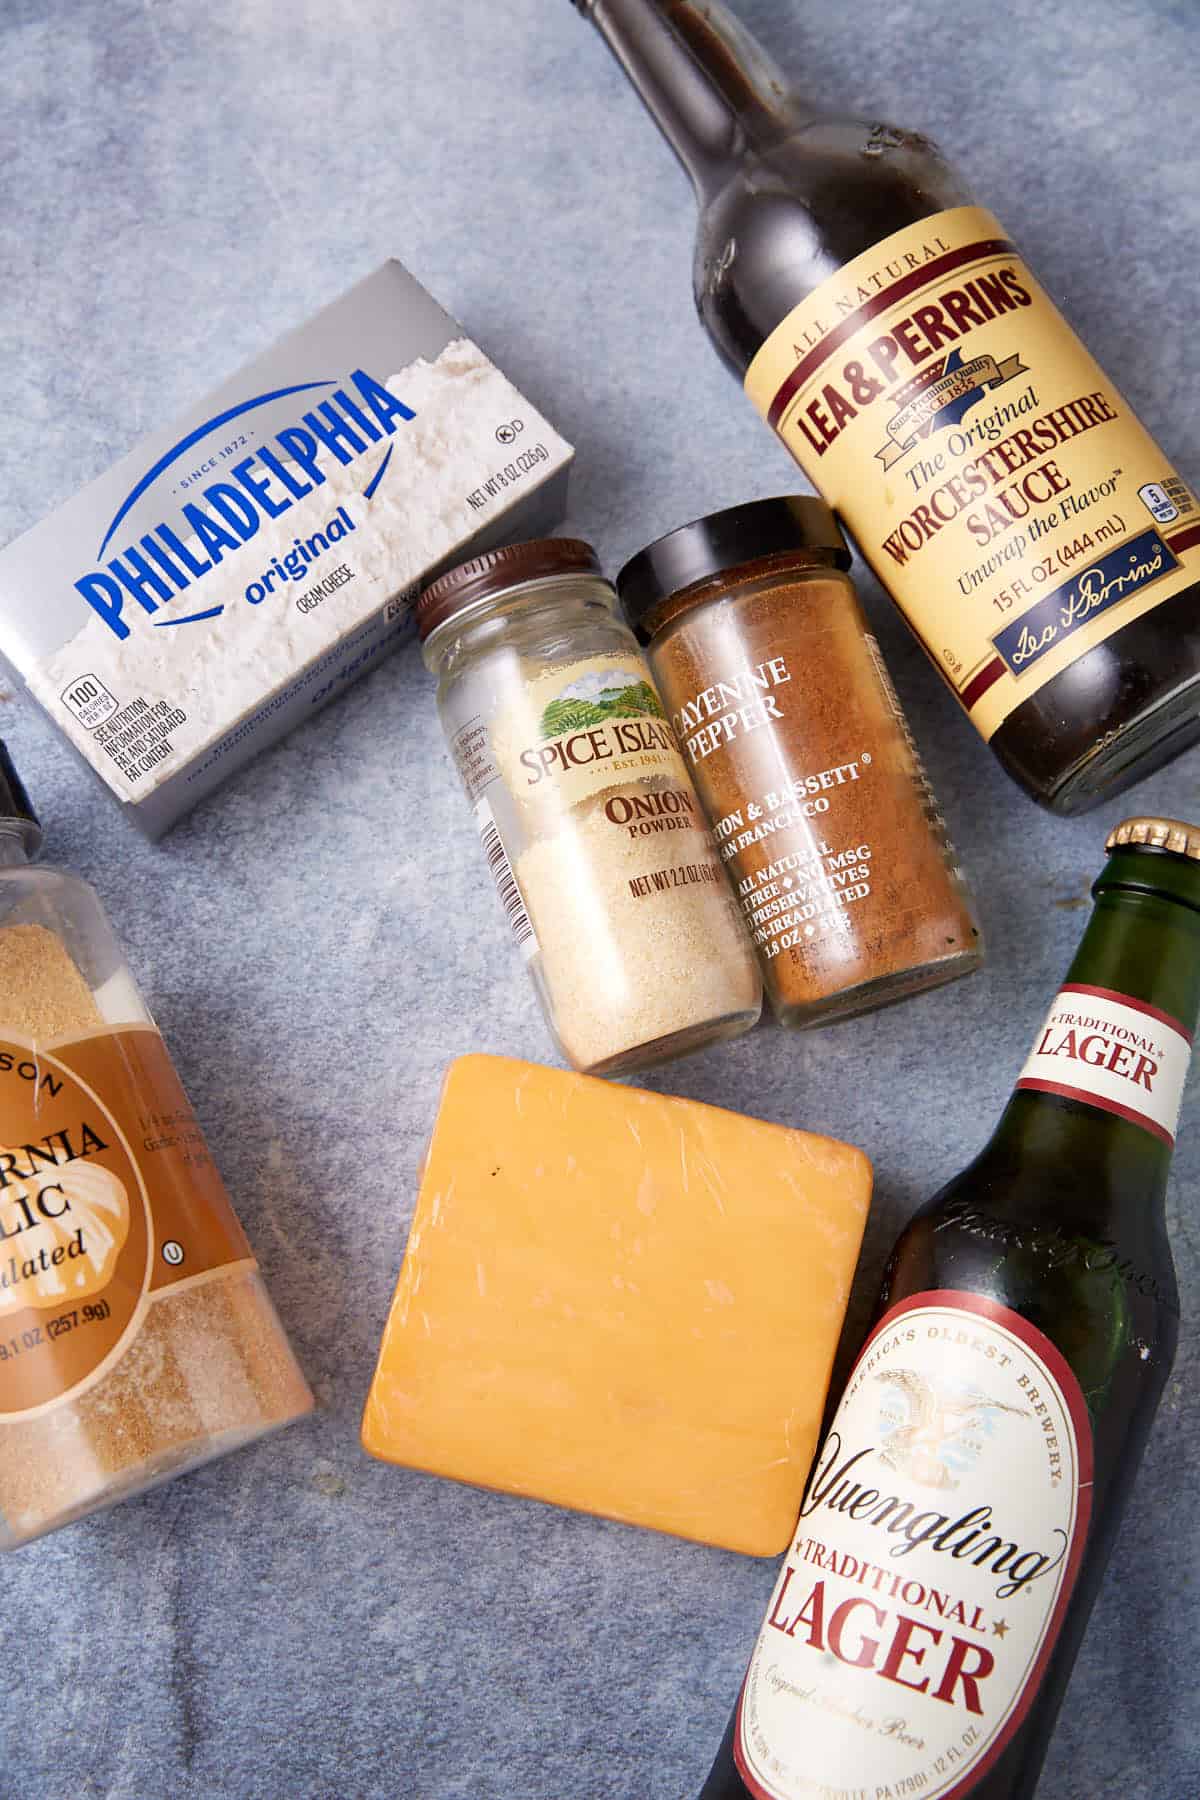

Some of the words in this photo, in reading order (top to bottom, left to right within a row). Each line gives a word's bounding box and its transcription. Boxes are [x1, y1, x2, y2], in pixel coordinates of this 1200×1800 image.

[791, 318, 829, 360] ALL
[835, 237, 952, 314] NATURAL
[954, 357, 991, 381] Quality
[911, 396, 946, 427] SINCE
[947, 376, 977, 399] 1835
[180, 457, 218, 489] SINCE
[219, 435, 248, 459] 1872
[904, 454, 946, 494] The
[948, 386, 1040, 457] Original
[74, 369, 417, 641] PHILADELPHIA
[466, 488, 488, 510] NET
[482, 477, 502, 497] WT
[496, 472, 509, 487] 8
[503, 463, 522, 481] OZ
[516, 443, 549, 473] (226g)
[881, 392, 1118, 568] WORCESTERSHIRE
[966, 460, 1071, 547] SAUCE
[1147, 488, 1160, 504] 5
[245, 506, 356, 605] original
[957, 534, 1028, 596] Unwrap
[1028, 514, 1059, 542] the
[993, 590, 1014, 613] 15
[1011, 578, 1033, 599] FL
[1032, 557, 1059, 583] OZ
[1055, 532, 1095, 567] (444
[1094, 514, 1127, 543] mL)
[296, 584, 328, 614] CREAM
[321, 563, 356, 594] CHEESE
[1012, 626, 1057, 665] Lea
[69, 681, 98, 708] 100
[93, 726, 112, 746] SEE
[106, 697, 150, 735] NUTRITION
[103, 711, 157, 758] INFORMATION
[151, 700, 172, 720] FOR
[113, 751, 132, 771] FAT
[128, 739, 148, 760] AND
[143, 709, 187, 747] SATURATED
[519, 731, 613, 784] SPICE
[612, 721, 681, 754] ISLAN
[686, 696, 784, 764] PEPPER
[124, 763, 142, 783] FAT
[138, 738, 174, 772] CONTENT
[604, 790, 694, 825] ONION
[629, 816, 692, 839] POWDER
[747, 803, 763, 821] &
[629, 872, 653, 898] NET
[650, 868, 671, 892] WT
[670, 865, 688, 887] 2.2
[686, 864, 701, 883] OZ
[738, 875, 757, 897] ALL
[749, 881, 780, 909] FREE
[827, 844, 872, 871] MSG
[752, 882, 870, 944] ON-IRRADITED
[781, 929, 802, 950] OZ
[1037, 1028, 1158, 1092] LAGER
[1059, 1013, 1155, 1056] TRADITIONAL
[0, 1053, 64, 1097] SON
[0, 1122, 109, 1190] RNIA
[0, 1183, 72, 1241] LIC
[22, 1327, 43, 1350] OZ
[46, 1299, 111, 1341] (257.9g)
[927, 1326, 1011, 1368] OLDEST
[1016, 1373, 1063, 1482] BREWERY
[800, 1432, 1068, 1599] Yuengling
[803, 1538, 987, 1633] TRADITIONAL
[768, 1566, 995, 1716] LAGER
[933, 1756, 947, 1775] 12
